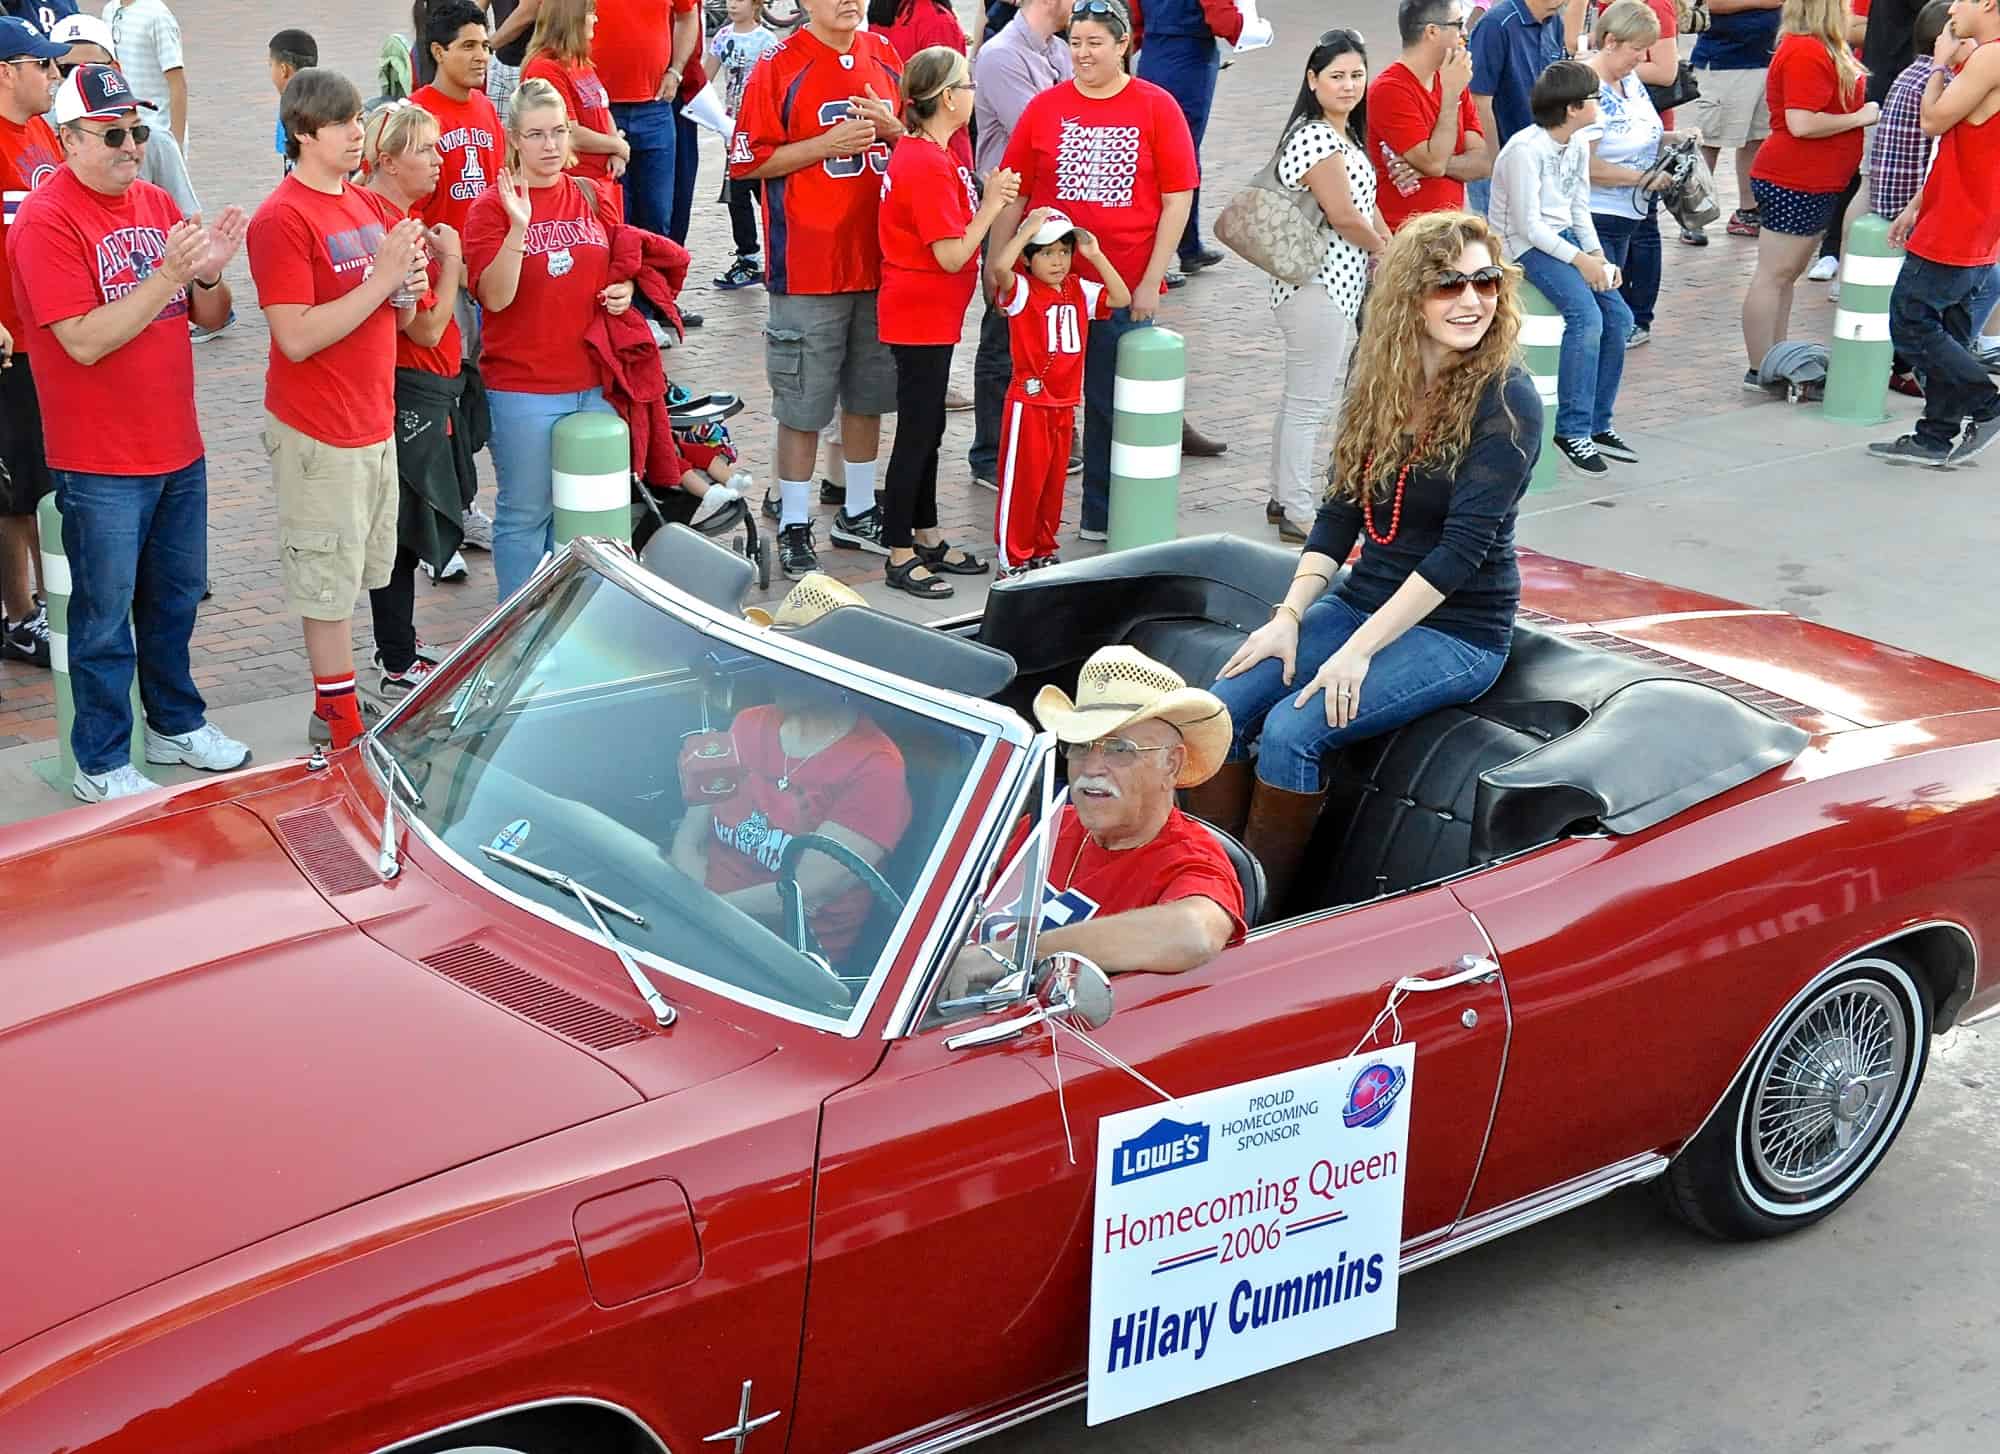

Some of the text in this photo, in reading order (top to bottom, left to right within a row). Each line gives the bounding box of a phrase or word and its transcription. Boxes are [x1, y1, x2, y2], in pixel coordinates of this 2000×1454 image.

[99, 71, 128, 97] A
[437, 127, 468, 152] VIVA
[461, 145, 485, 181] A
[96, 226, 167, 286] ARIZON
[524, 217, 609, 257] RIZONA
[1045, 304, 1082, 354] 10
[1220, 1101, 1319, 1138] HOMECOMING
[1248, 1089, 1295, 1113] PROUD
[1121, 1133, 1202, 1177] LOWE'S
[1236, 1122, 1301, 1151] SPONSOR
[1104, 1150, 1398, 1254] Homecoming Queen
[1219, 1218, 1282, 1264] 2006
[1107, 1250, 1384, 1374] Hilary Cummins
